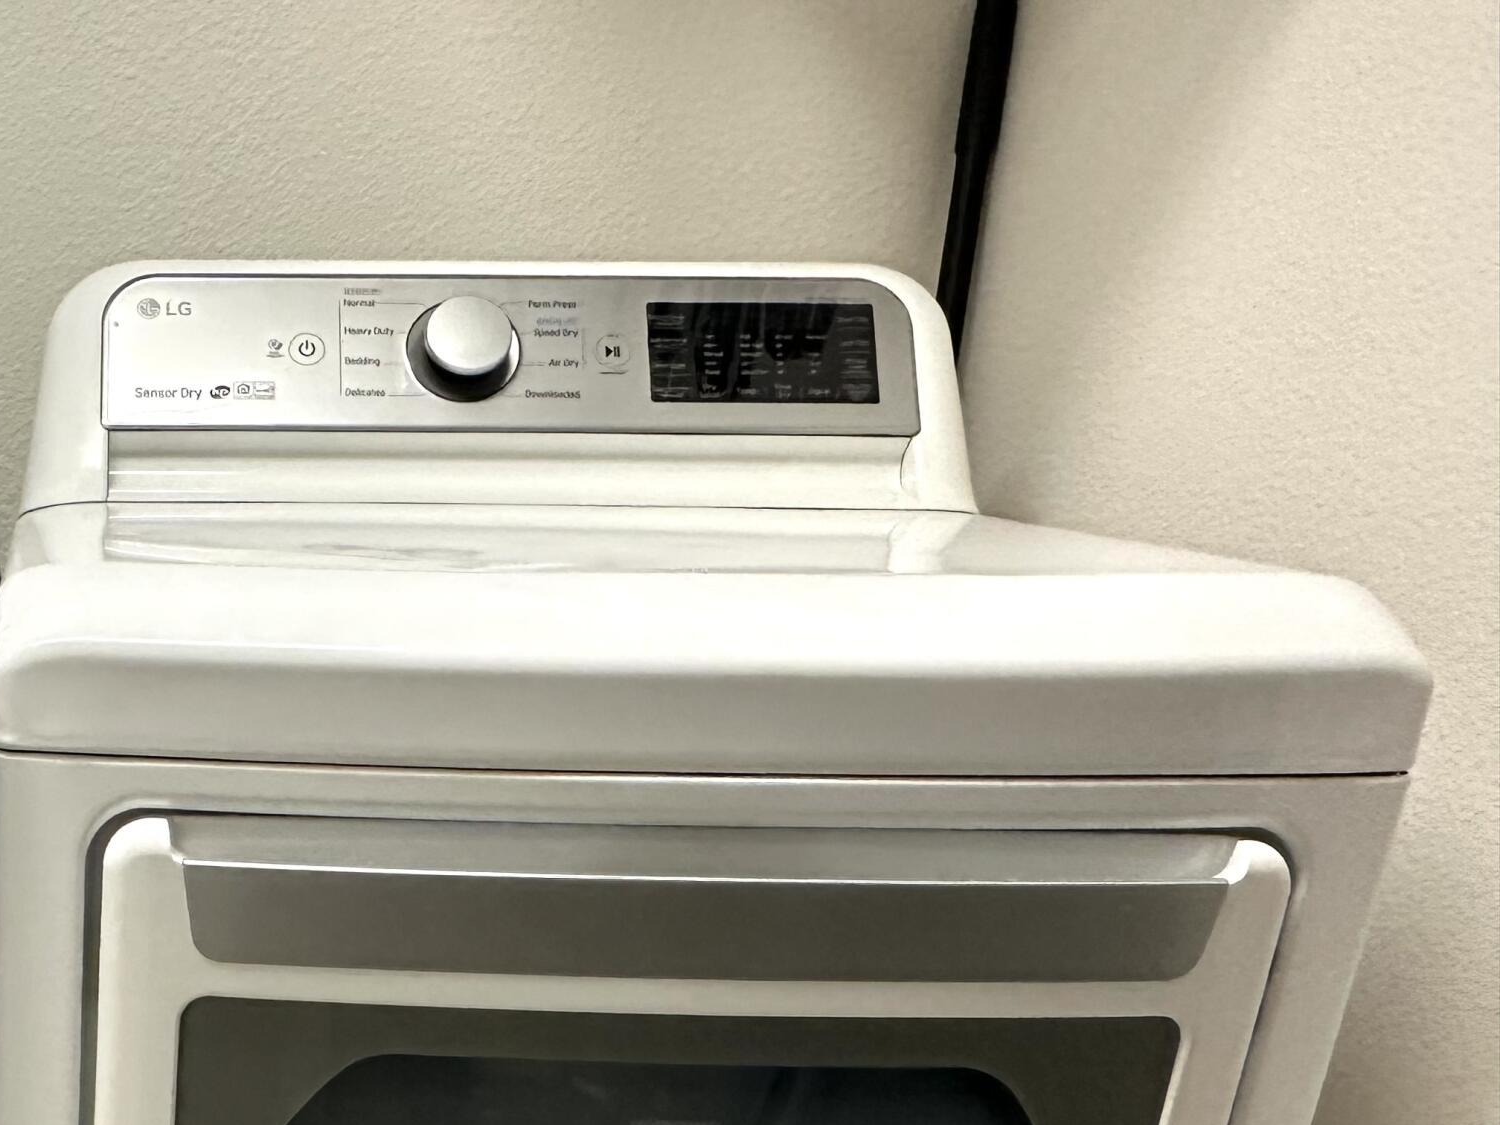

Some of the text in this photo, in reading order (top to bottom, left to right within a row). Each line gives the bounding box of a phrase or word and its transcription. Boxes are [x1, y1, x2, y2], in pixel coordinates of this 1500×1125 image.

[166, 301, 192, 316] LG
[135, 386, 203, 401] Sensor Dry
